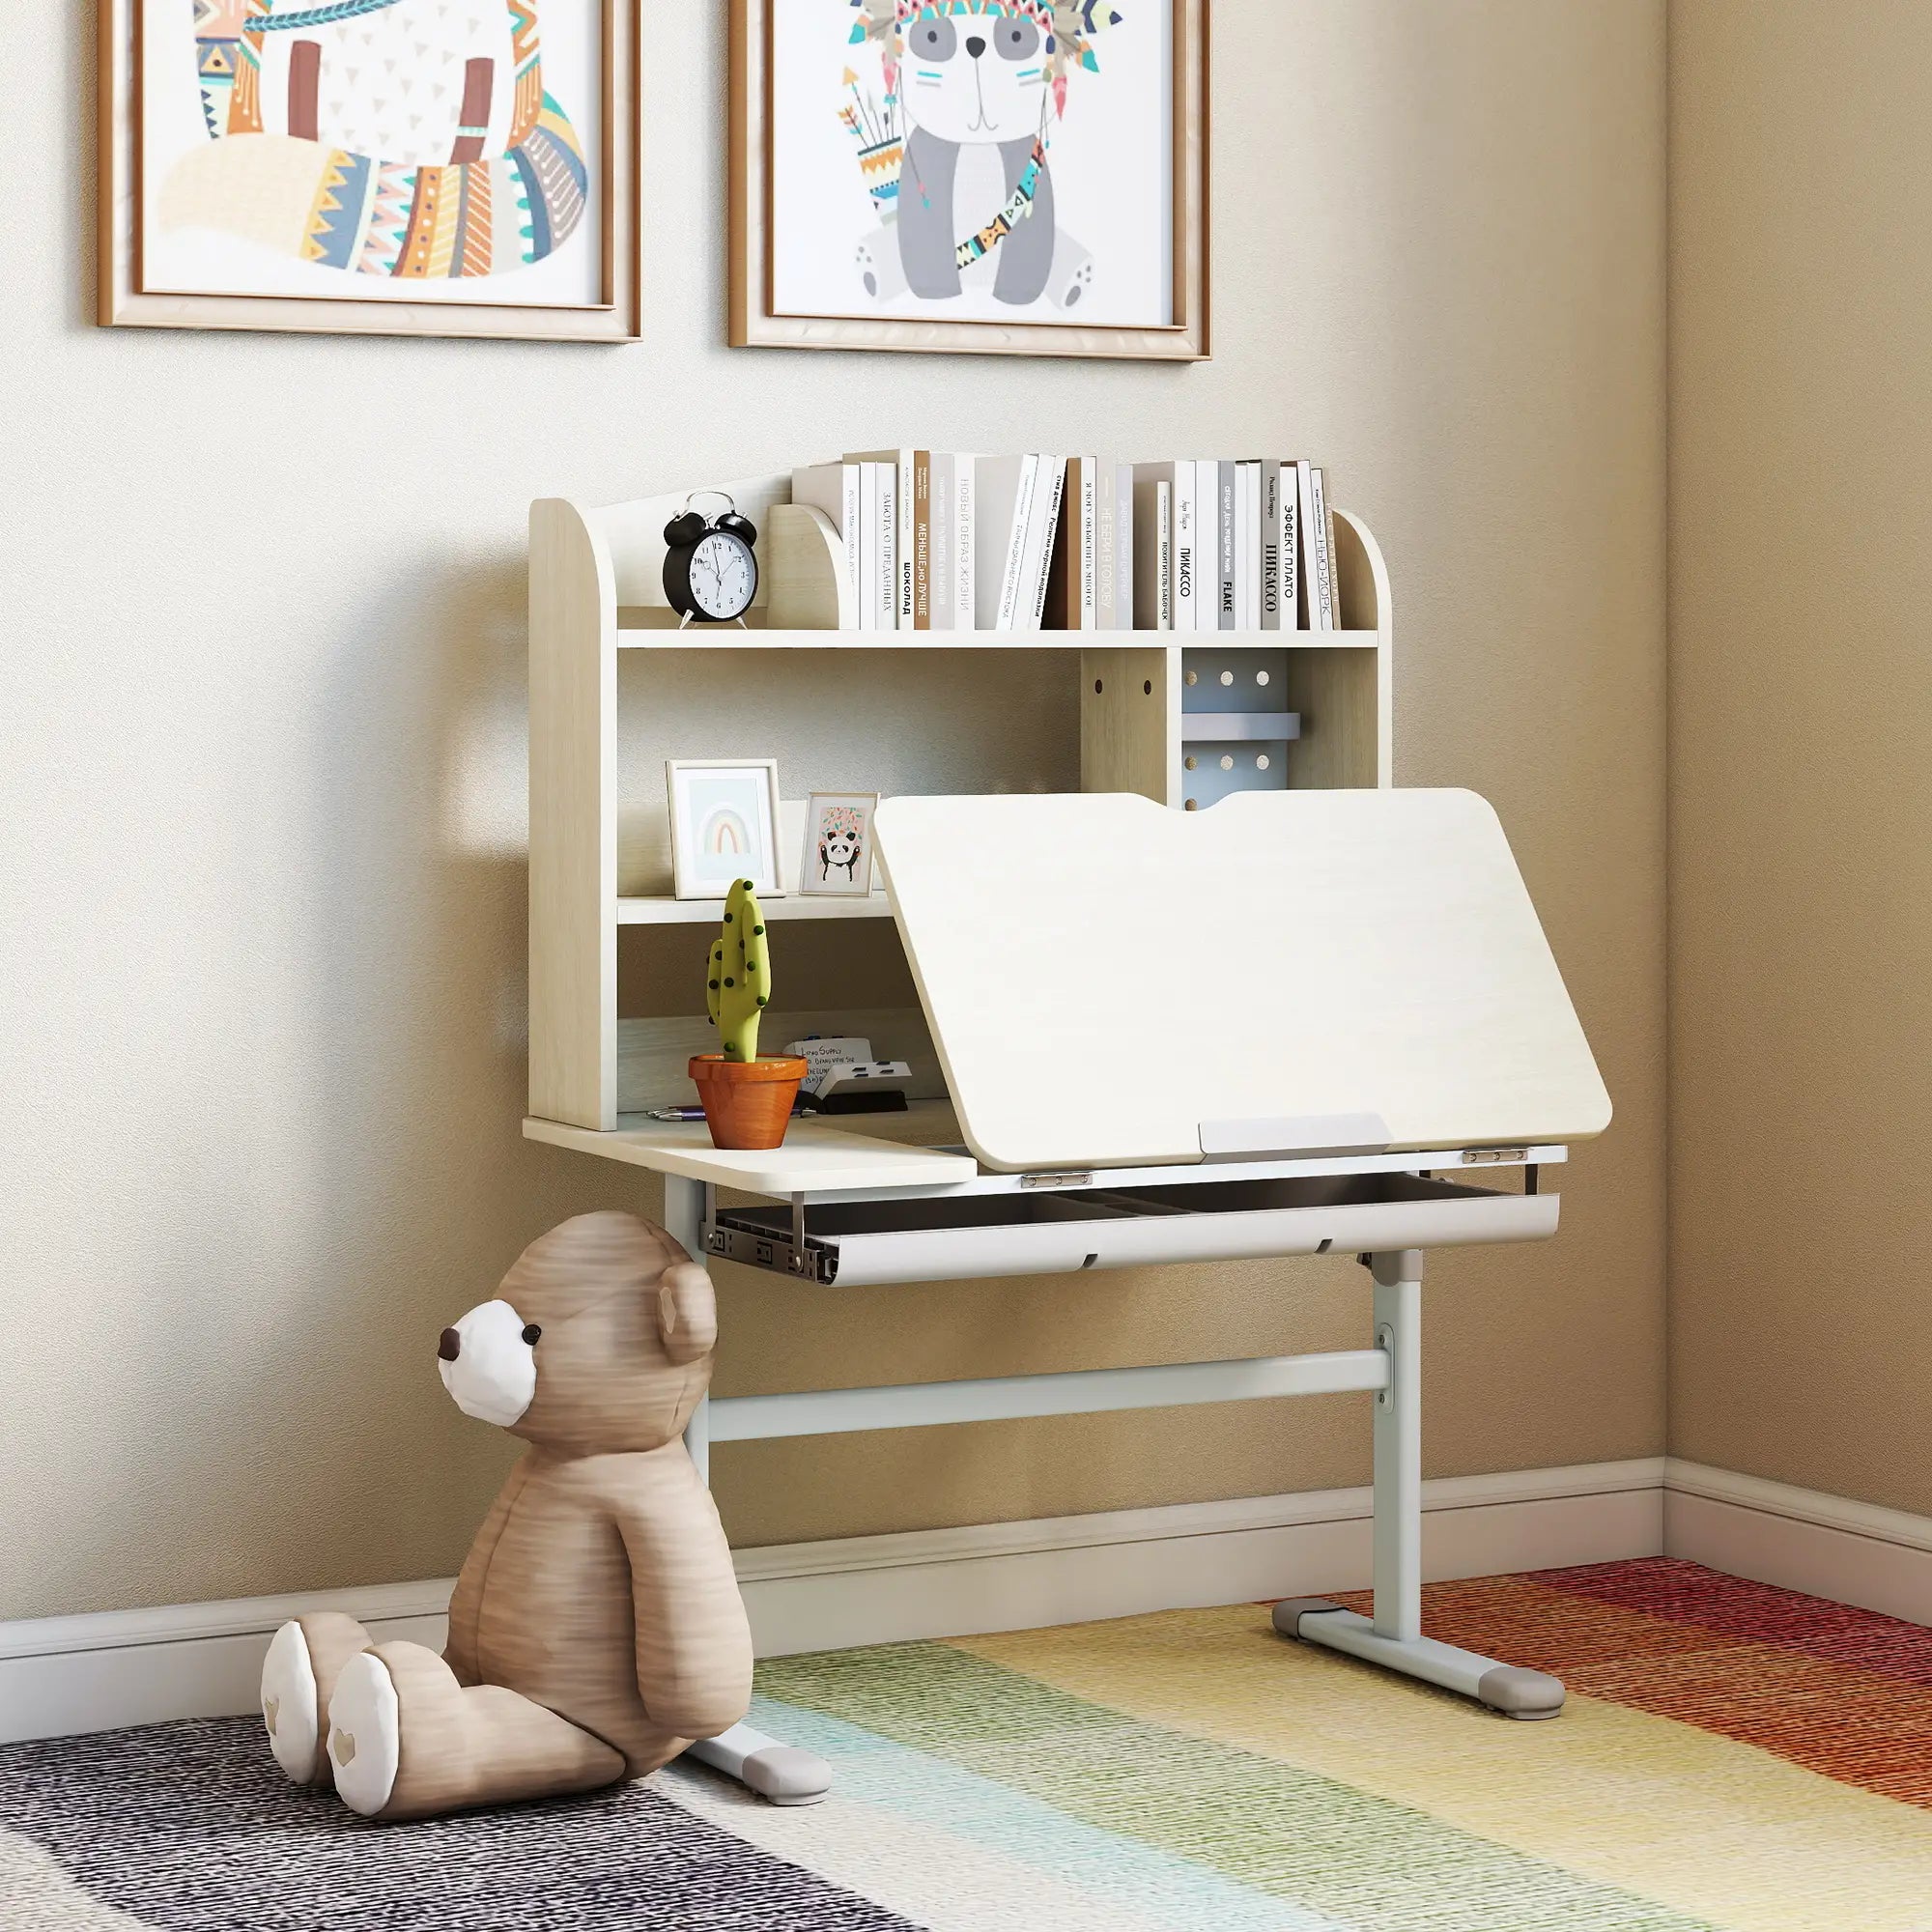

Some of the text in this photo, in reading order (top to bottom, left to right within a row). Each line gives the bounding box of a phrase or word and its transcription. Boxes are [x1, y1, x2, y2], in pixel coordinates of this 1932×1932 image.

[1044, 517, 1057, 549] Религия
[1101, 507, 1113, 522] НЕ
[1222, 511, 1232, 526] ДЕНЬ
[1325, 502, 1334, 529] РОСС
[883, 492, 892, 612] ЗАБОТА О ПРЕДАННЫХ
[960, 478, 971, 611] НОВЫЙ ОБРАЗ ЖИЗНИ
[1101, 524, 1113, 554] БЕРИ
[1284, 504, 1293, 599] ЭФФЕКТ ПЛАТО
[902, 562, 911, 615] ШОКОЛАД
[1101, 564, 1113, 609] ГОЛОВУ
[1179, 548, 1191, 597] ПИКАССО
[1264, 544, 1277, 612] ПИКАССО
[918, 582, 927, 616] ЛУЧШЕ
[1035, 578, 1046, 617] водолазки
[1223, 582, 1233, 611] FLAKE
